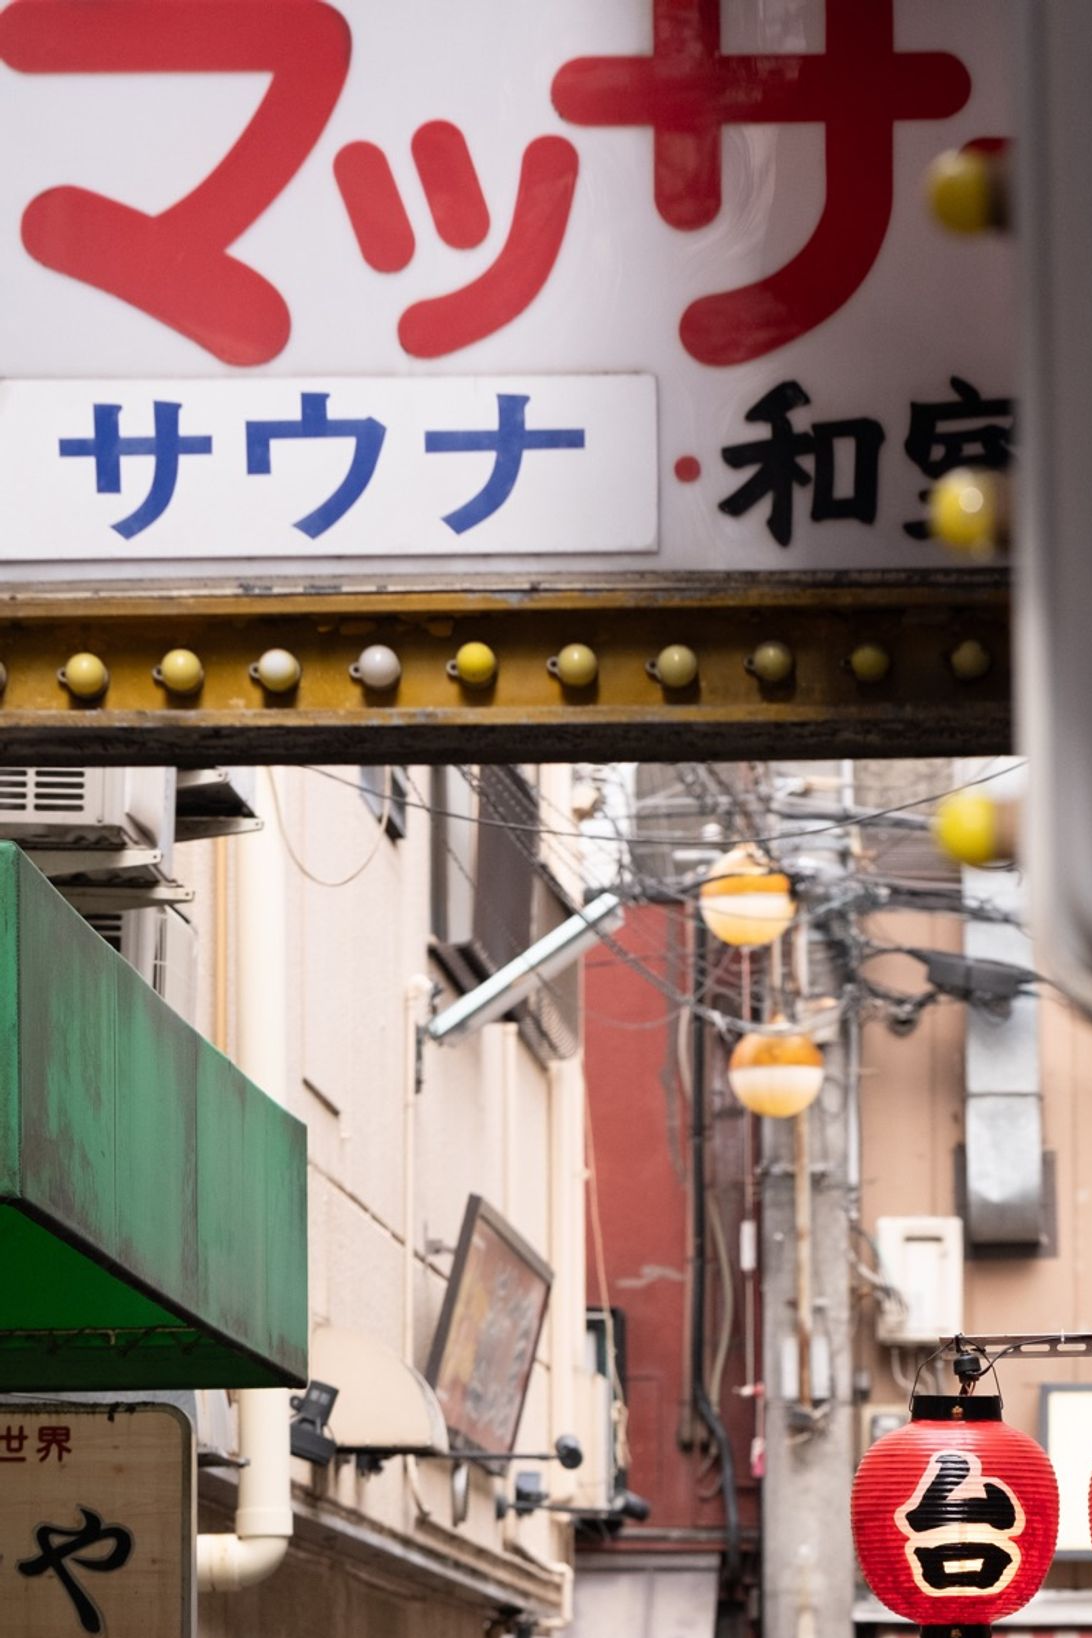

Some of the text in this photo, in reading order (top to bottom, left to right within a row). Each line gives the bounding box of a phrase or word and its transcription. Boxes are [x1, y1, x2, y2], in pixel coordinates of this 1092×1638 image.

[0, 0, 1014, 367] マッサ
[58, 391, 586, 540] サウナ
[17, 1507, 134, 1635] や
[900, 1451, 1022, 1594] 台
